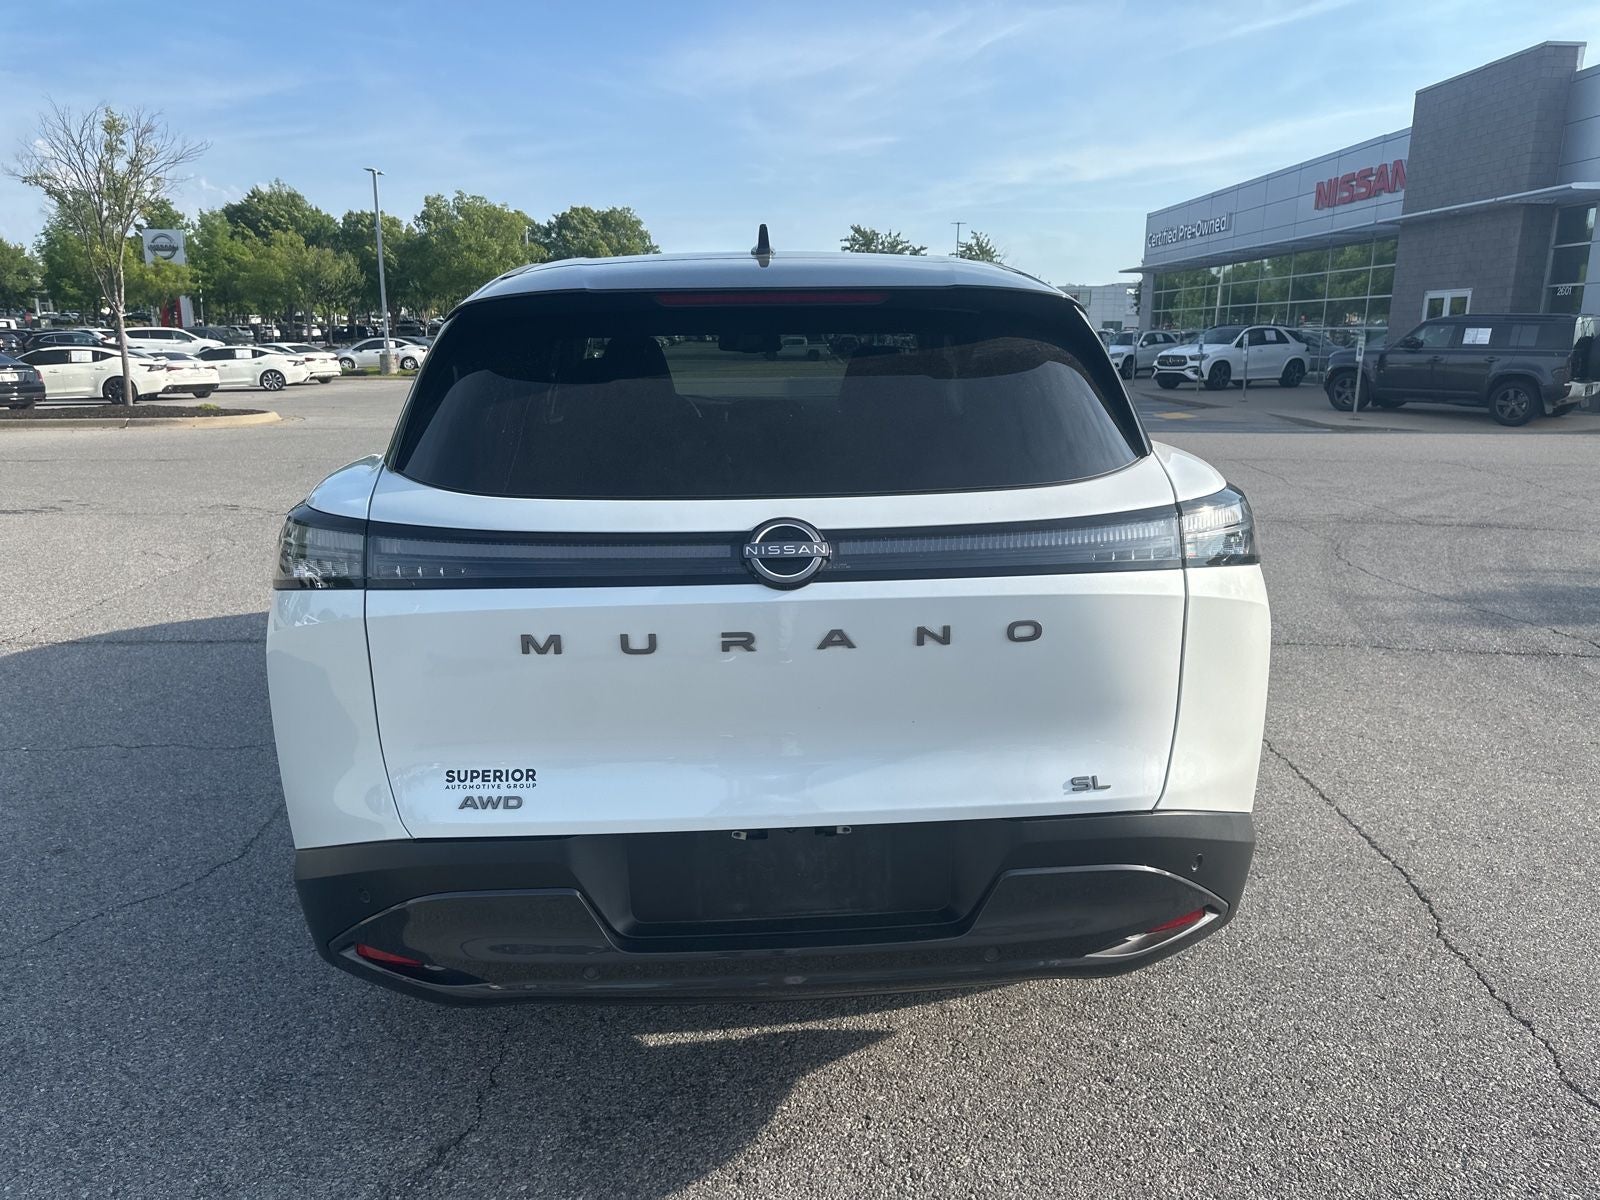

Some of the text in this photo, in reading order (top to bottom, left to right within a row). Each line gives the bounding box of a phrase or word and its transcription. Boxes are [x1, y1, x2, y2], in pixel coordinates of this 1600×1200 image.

[1314, 159, 1407, 210] NISSAN
[1148, 211, 1228, 248] Certified Pre-Owned
[1556, 286, 1572, 296] 2601
[745, 544, 826, 556] NISSAN
[520, 619, 1043, 656] MURANO
[445, 768, 537, 783] SUPERIOR
[1070, 775, 1112, 792] SL
[458, 795, 523, 810] AWD
